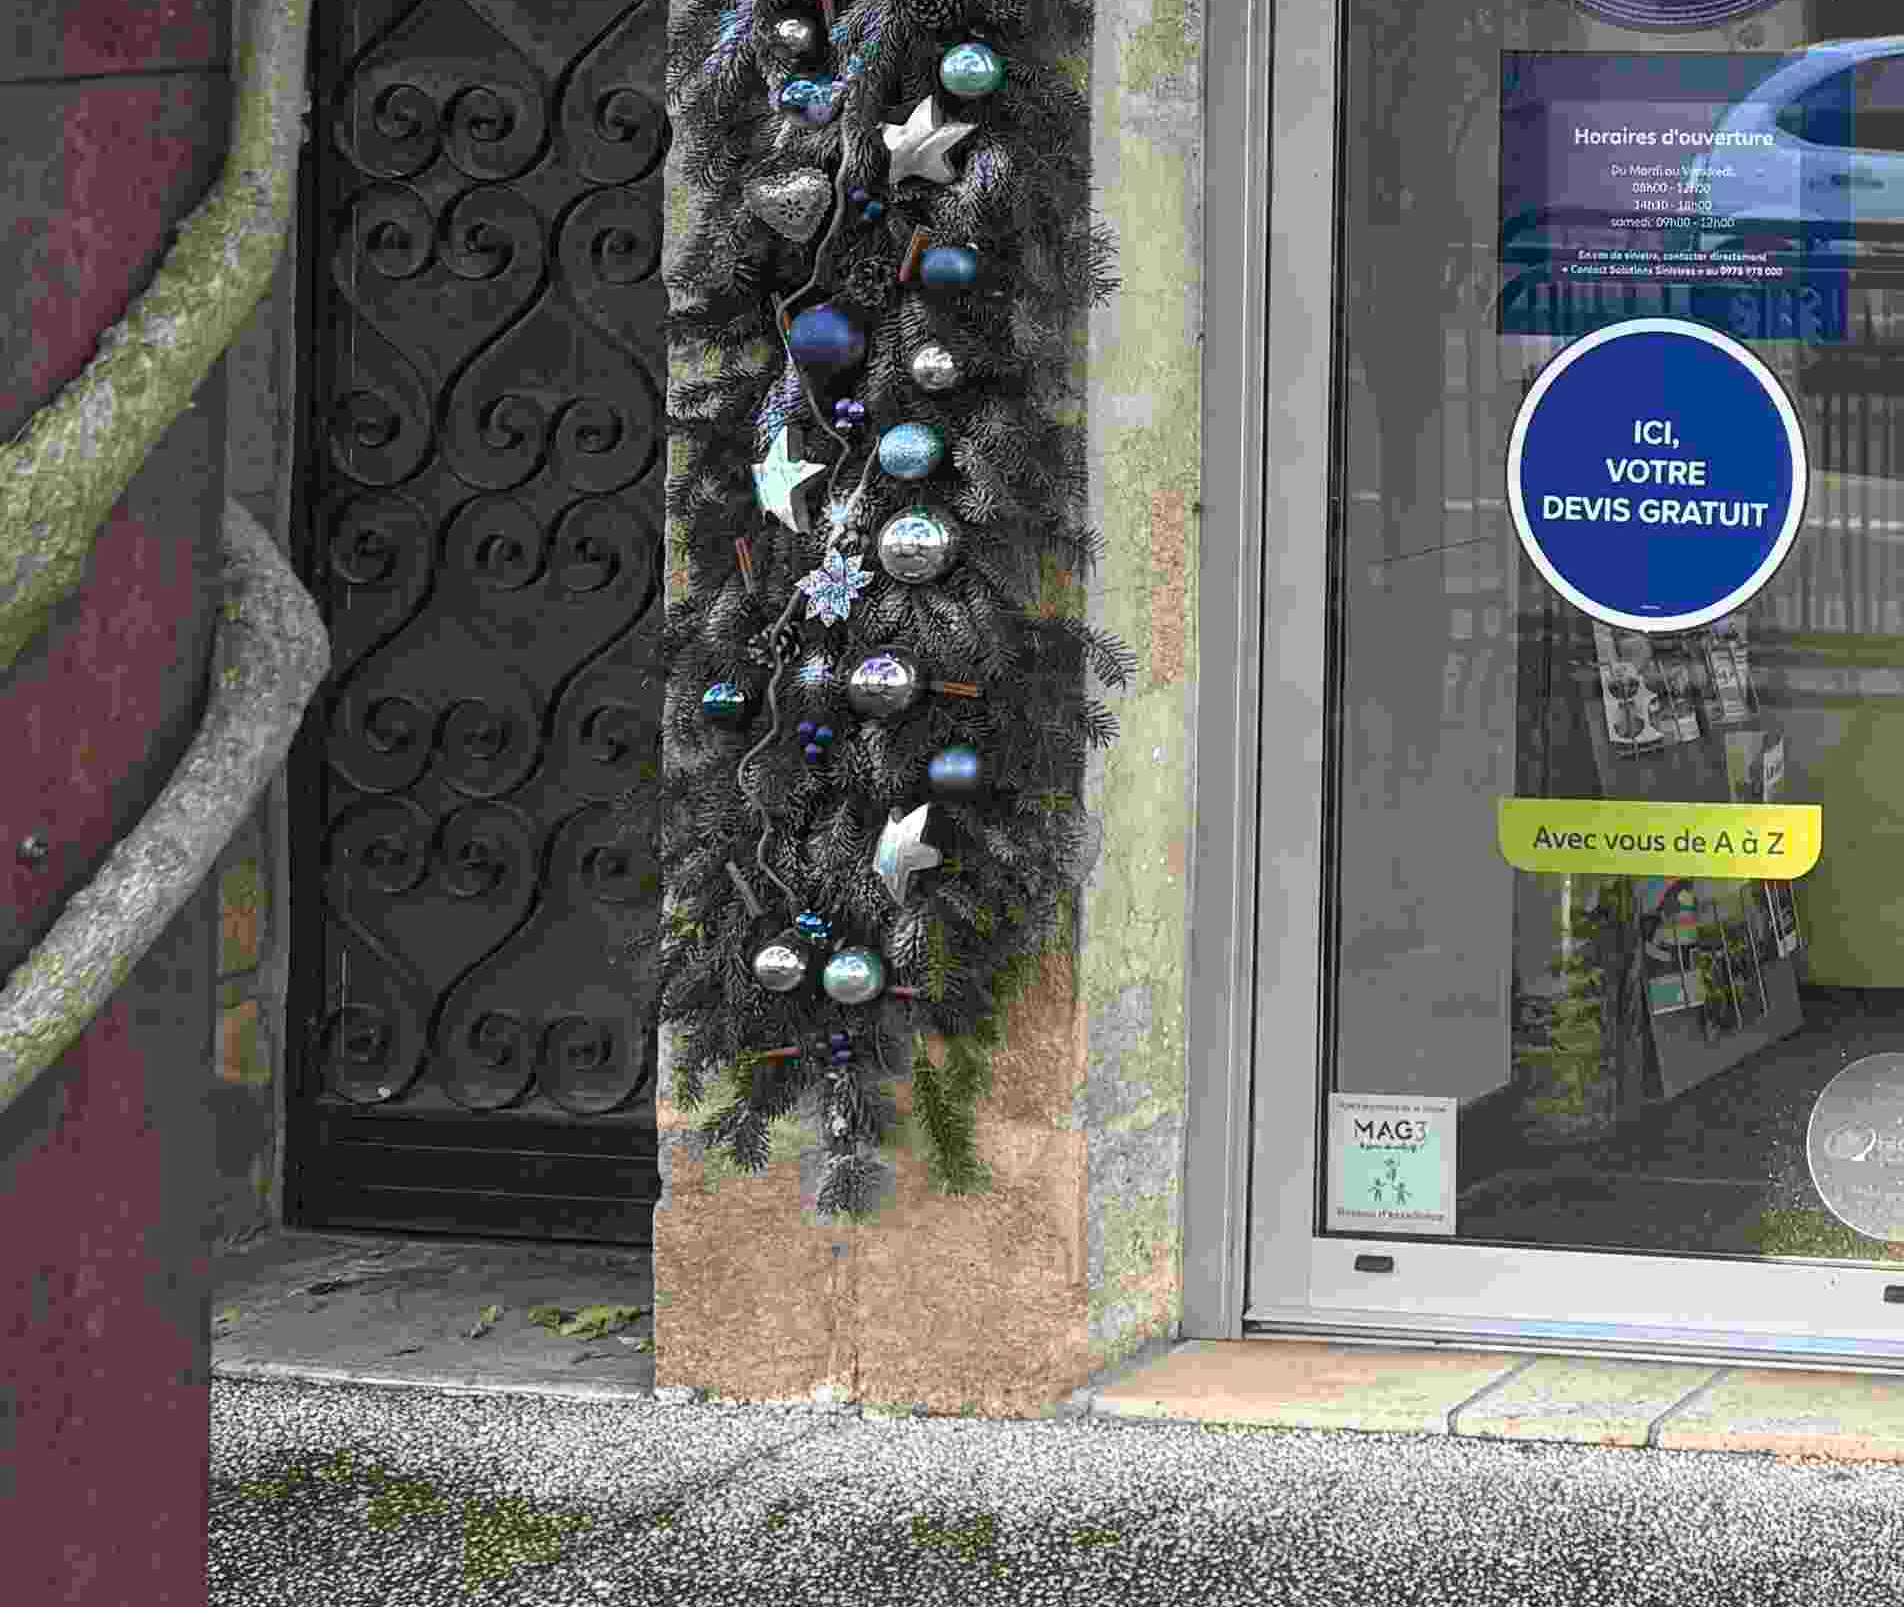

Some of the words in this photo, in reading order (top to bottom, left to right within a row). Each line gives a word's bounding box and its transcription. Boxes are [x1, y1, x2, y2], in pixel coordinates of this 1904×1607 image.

[1574, 126, 1657, 146] Horaires
[1661, 126, 1776, 147] d'ouverture
[1633, 419, 1681, 450] ICI,
[1605, 457, 1707, 487] VOTRE
[1543, 495, 1632, 523] DEVIS
[1638, 497, 1769, 528] GRATUIT
[1532, 825, 1598, 851] Avec
[1602, 830, 1666, 852] vous
[1672, 827, 1707, 854] de
[1713, 831, 1735, 855] A
[1741, 830, 1759, 856] à
[1766, 832, 1786, 857] Z
